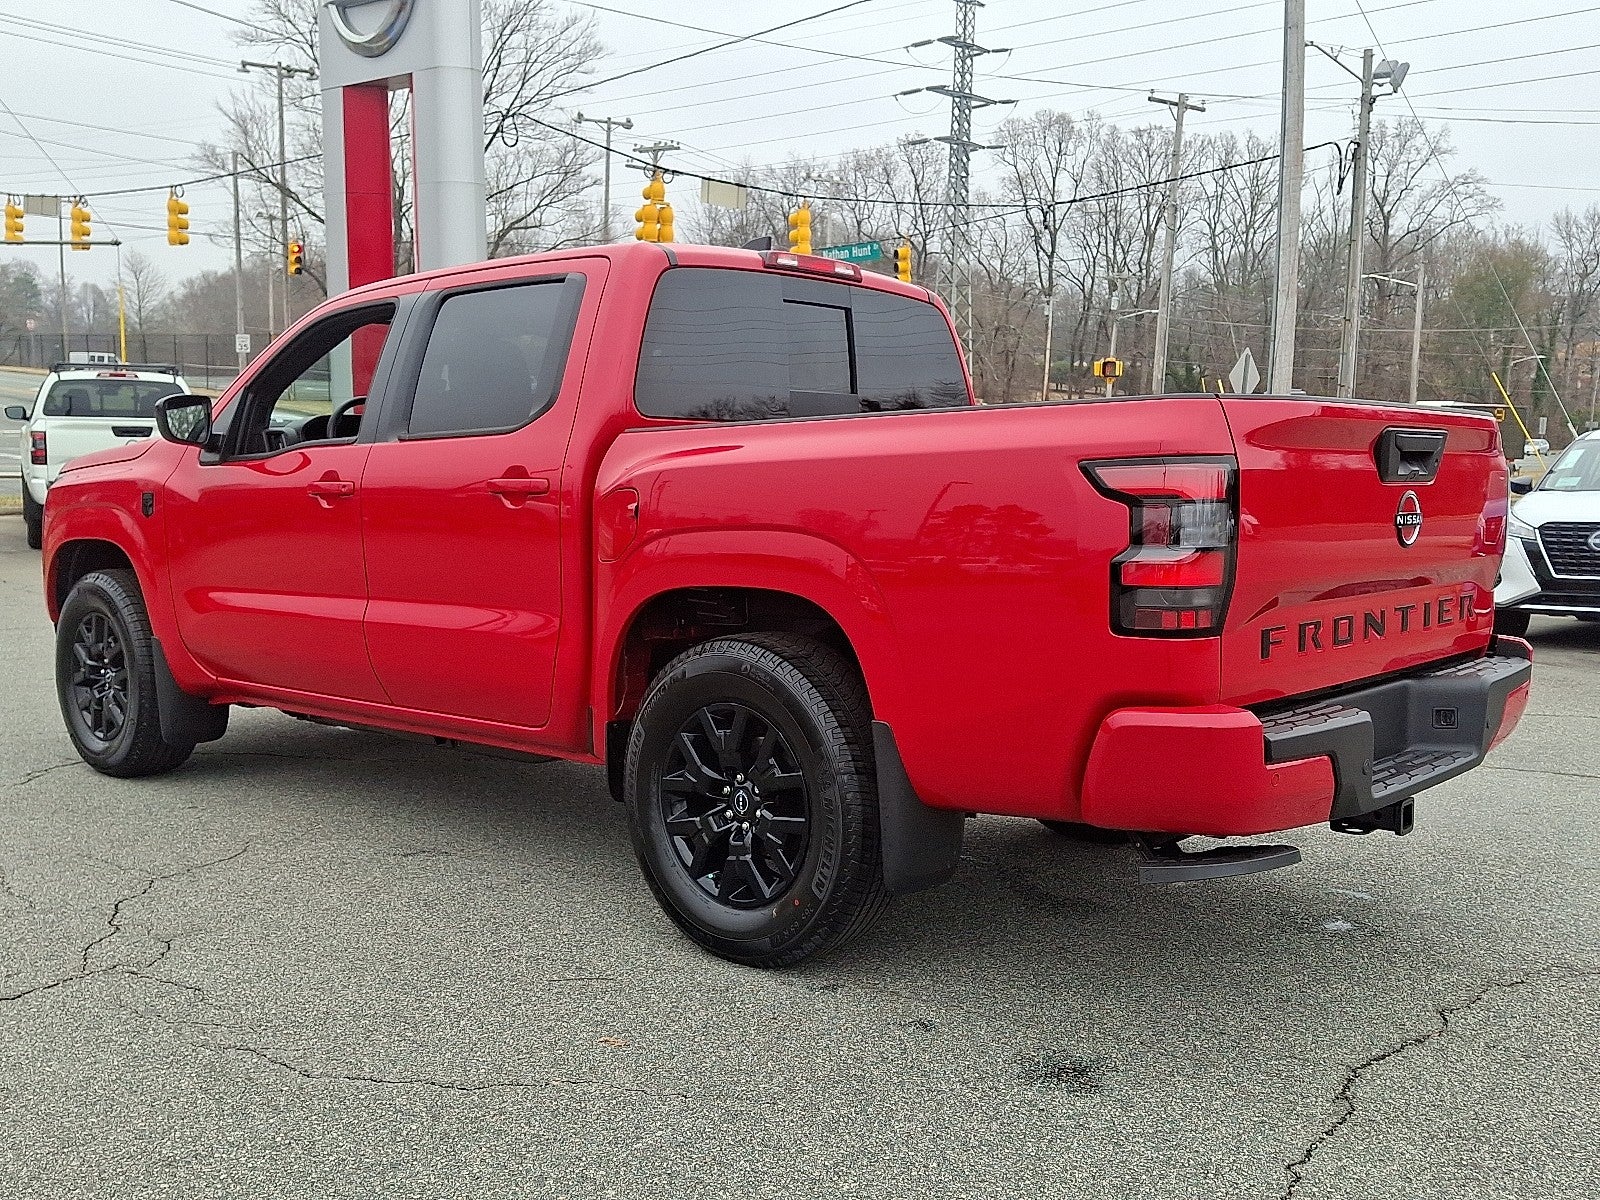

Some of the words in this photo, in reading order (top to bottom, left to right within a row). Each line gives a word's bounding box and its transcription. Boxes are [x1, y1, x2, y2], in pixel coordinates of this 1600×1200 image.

[822, 249, 850, 259] Nathan
[852, 244, 871, 258] Hunt
[239, 343, 249, 351] 35
[1260, 594, 1476, 660] FRONTIER
[814, 797, 835, 894] MICHELIN
